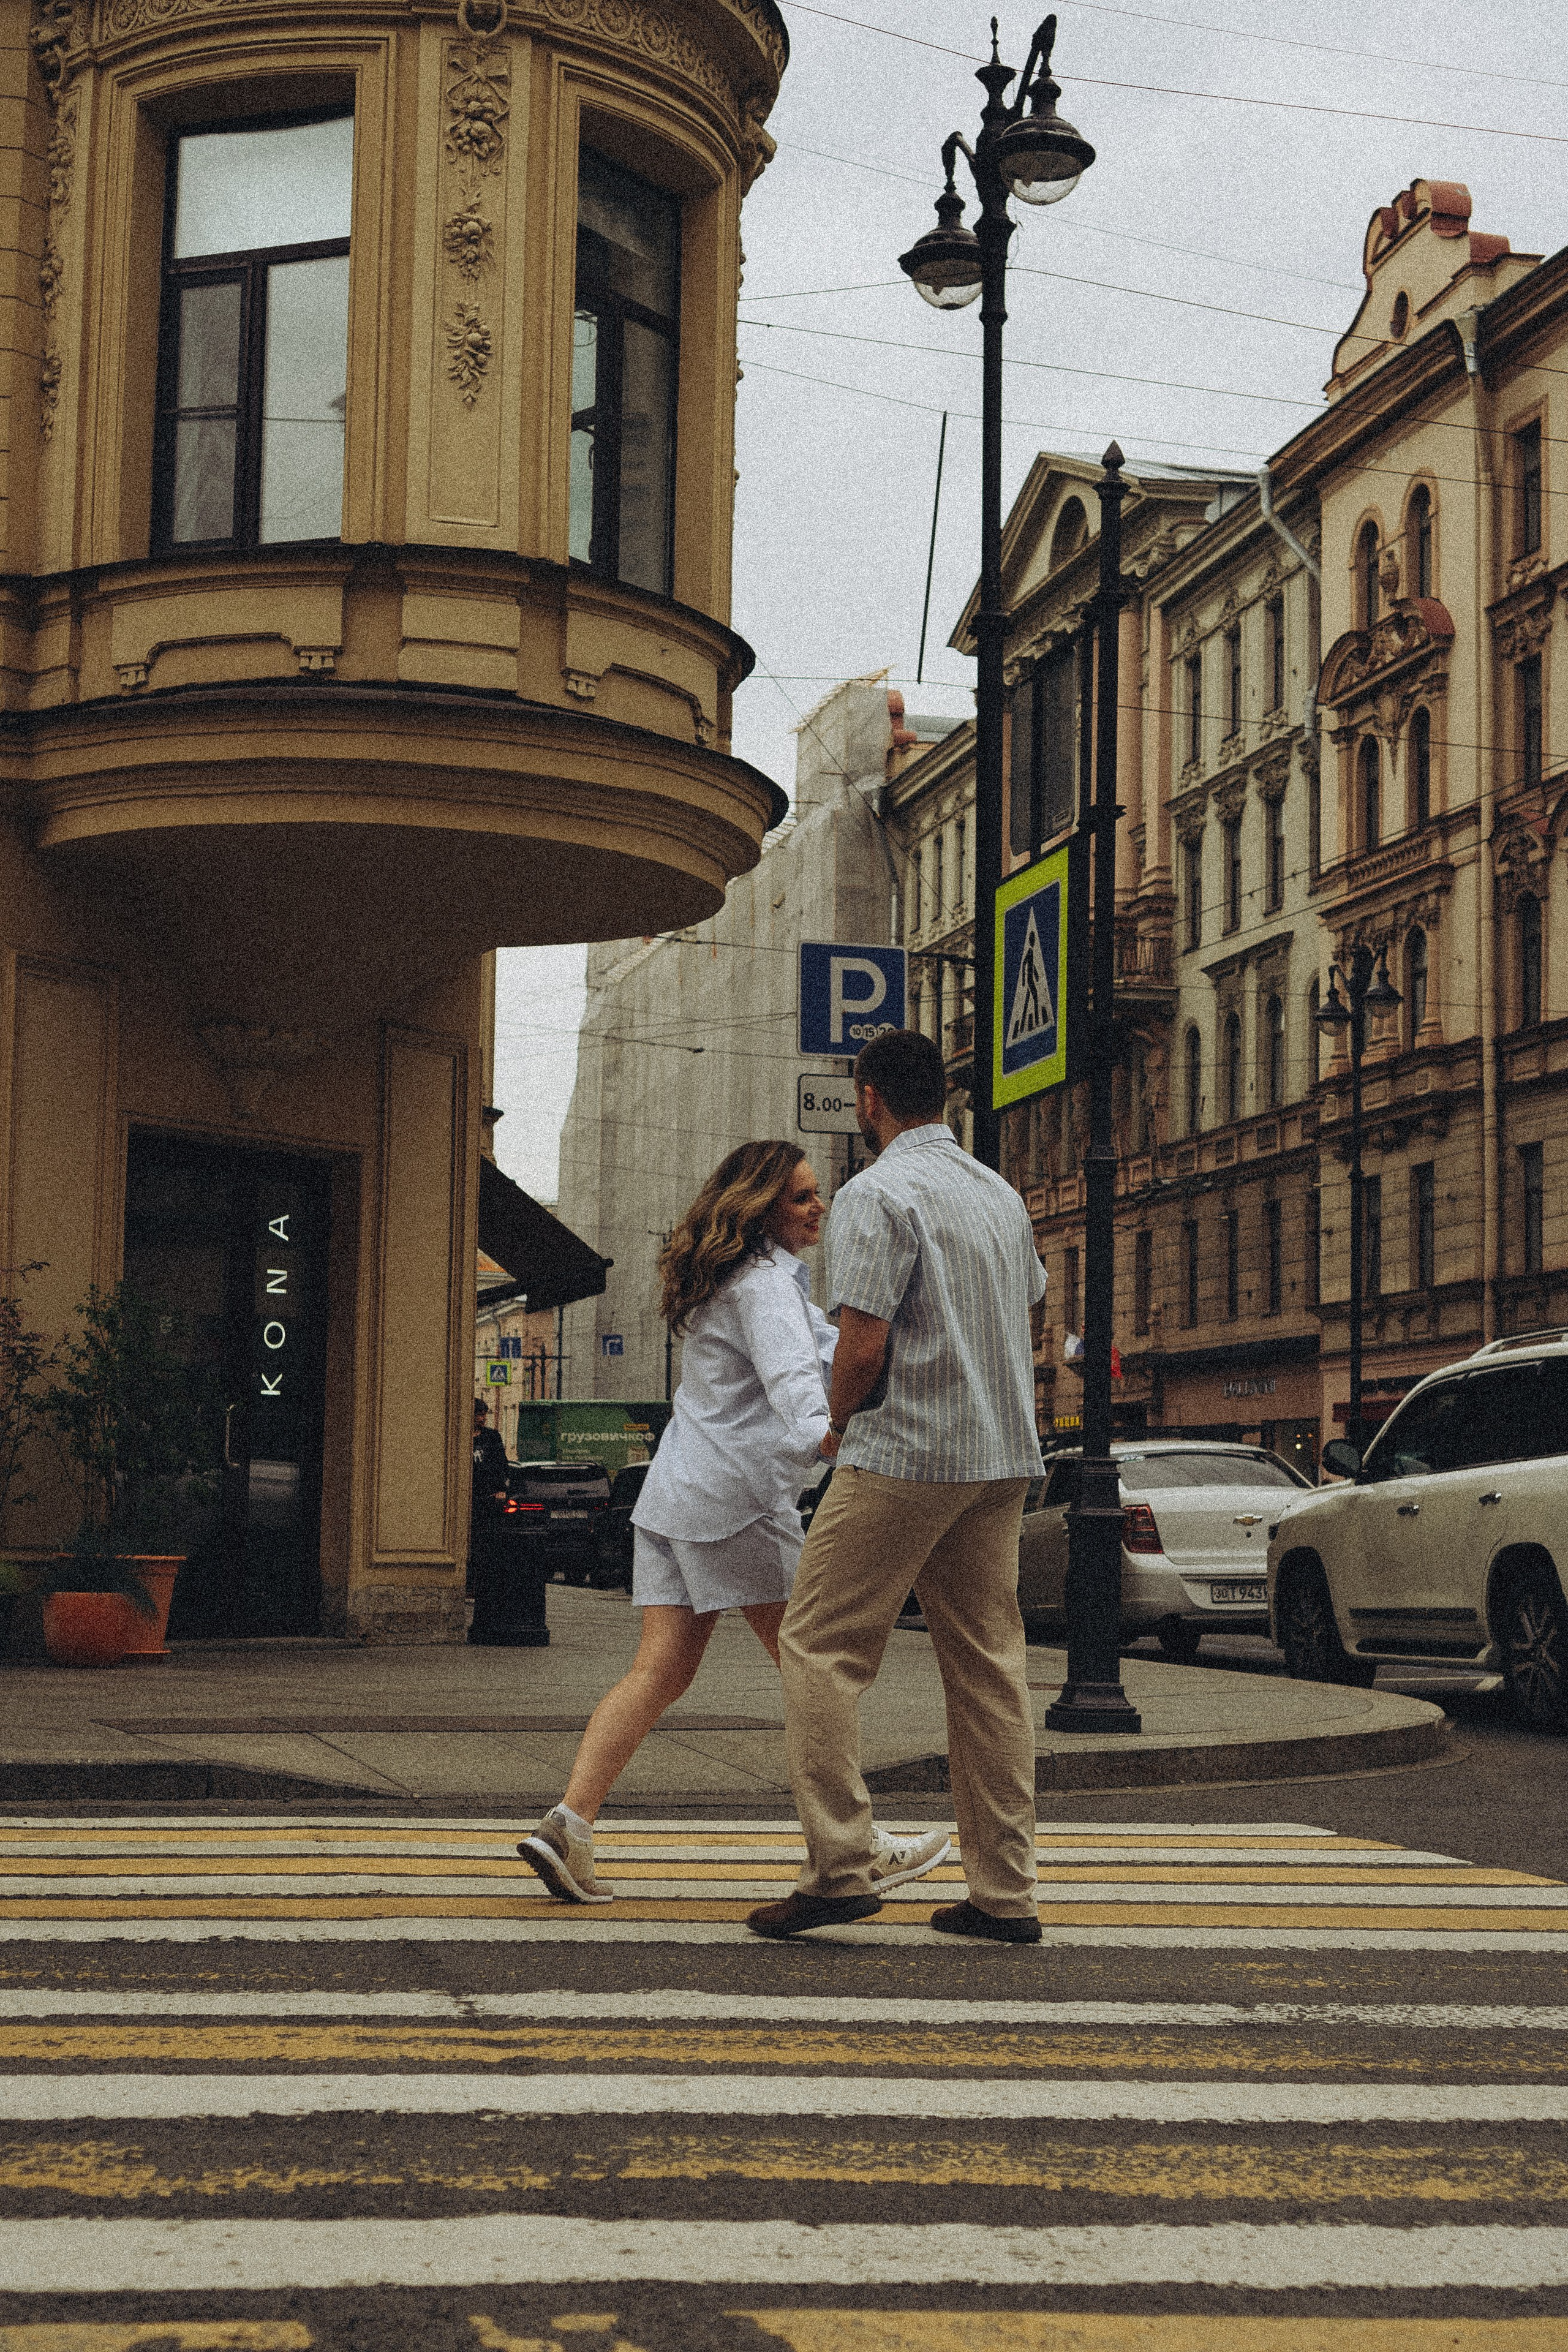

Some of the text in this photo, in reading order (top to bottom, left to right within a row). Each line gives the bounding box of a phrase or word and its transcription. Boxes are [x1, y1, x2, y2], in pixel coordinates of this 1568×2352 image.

[830, 956, 887, 1043] P
[864, 1027, 875, 1038] 15
[260, 1214, 290, 1396] KONA
